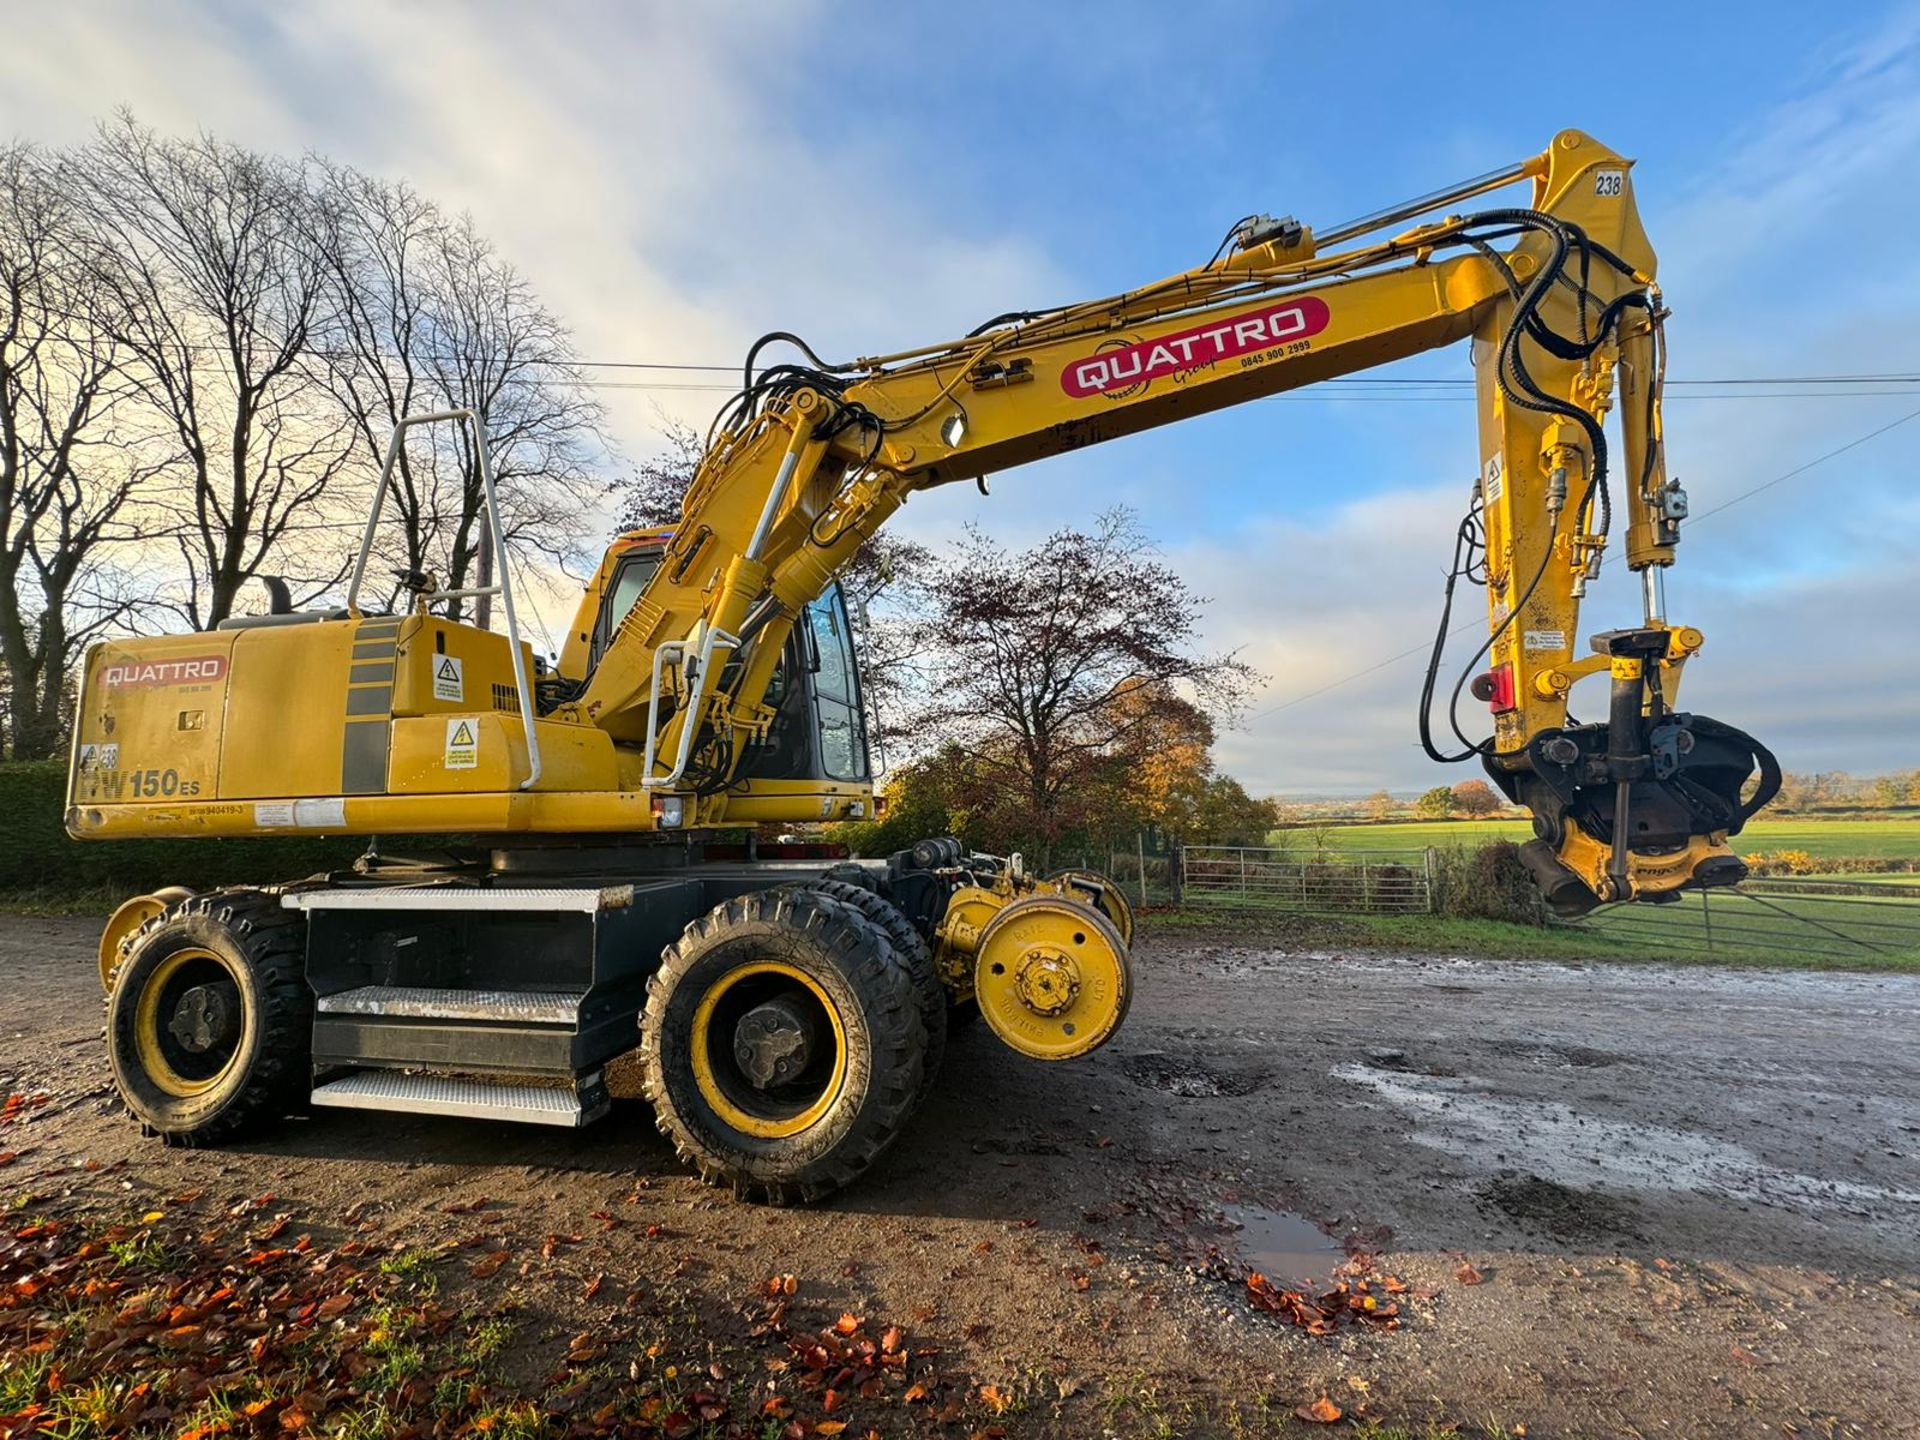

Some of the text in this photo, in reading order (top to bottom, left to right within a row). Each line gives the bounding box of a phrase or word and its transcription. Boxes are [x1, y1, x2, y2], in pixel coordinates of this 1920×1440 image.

[1596, 176, 1621, 196] 238
[1076, 307, 1306, 390] QUATTRO
[1241, 340, 1311, 368] 0845 900 2999
[1172, 354, 1217, 383] Group
[106, 660, 218, 686] QUATTRO
